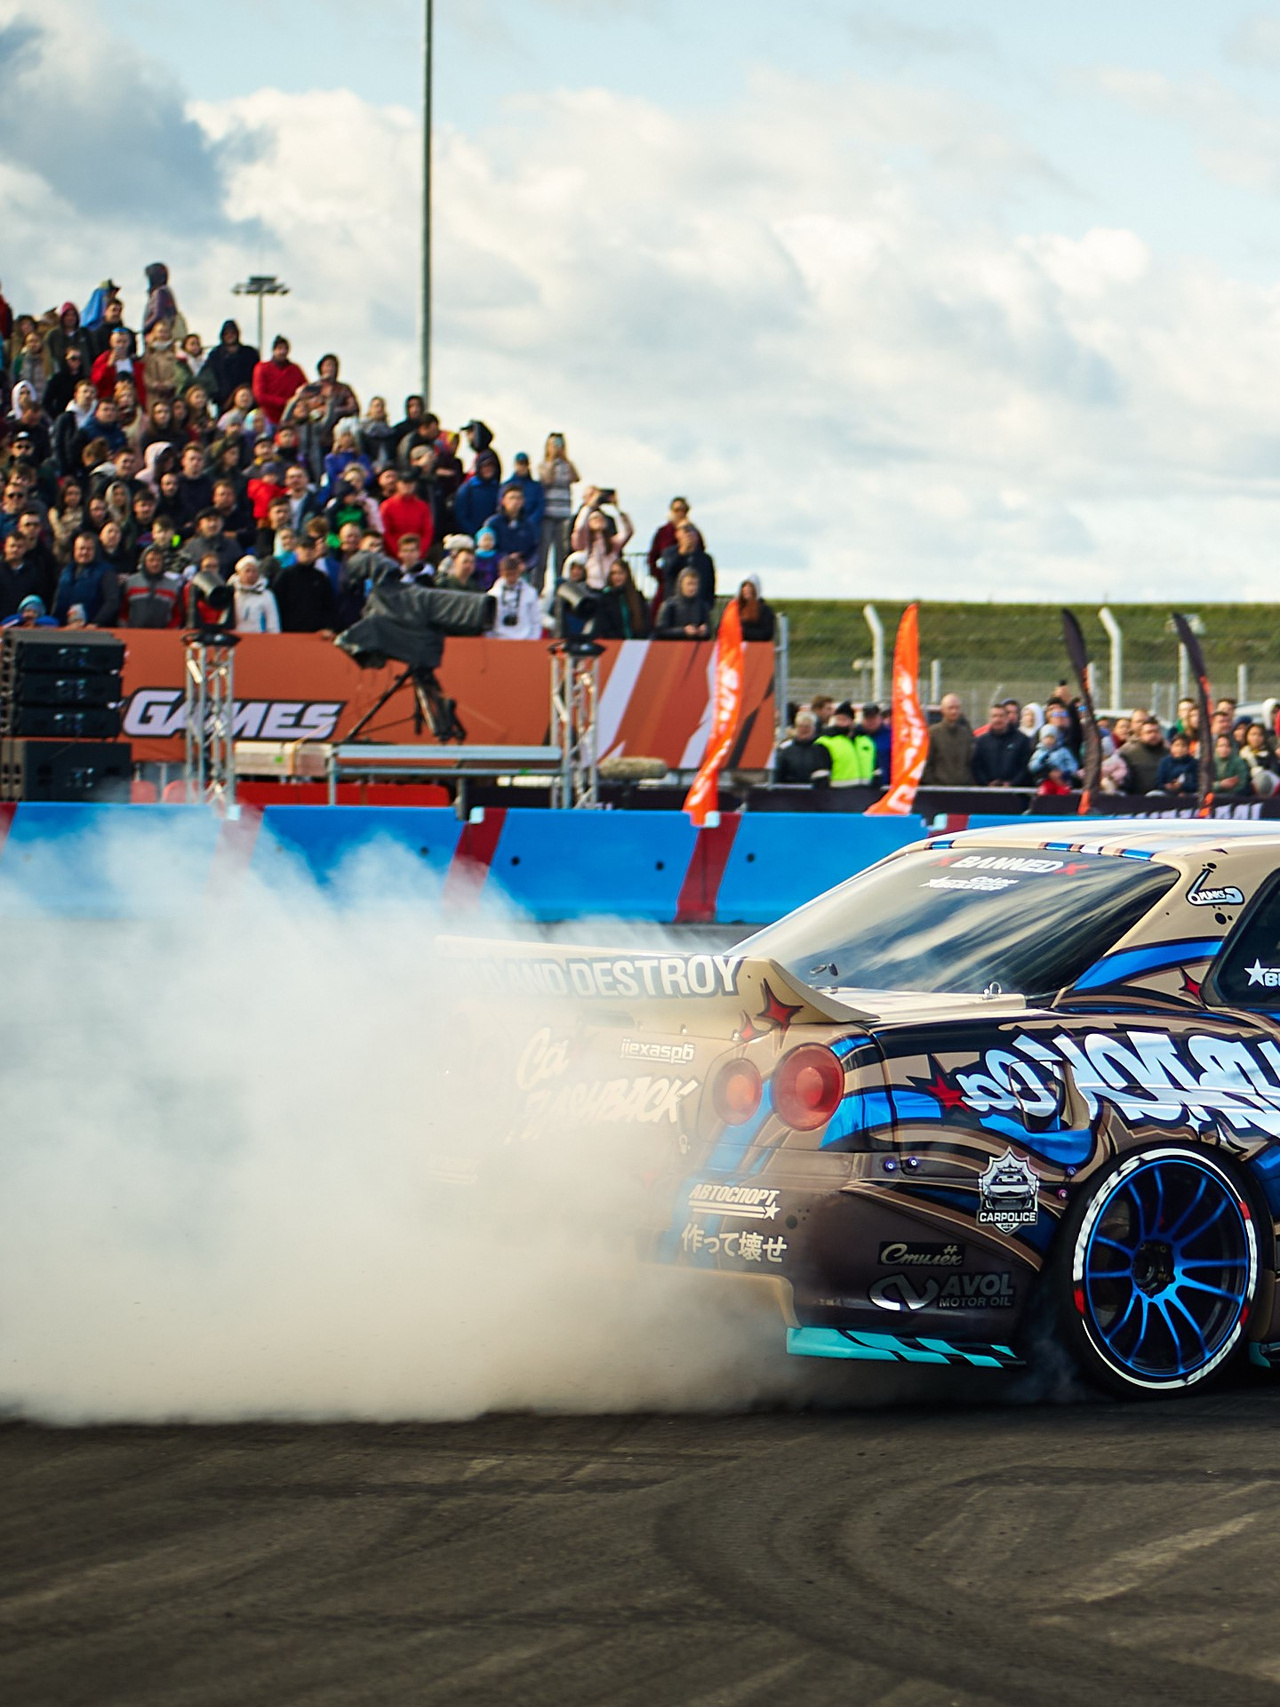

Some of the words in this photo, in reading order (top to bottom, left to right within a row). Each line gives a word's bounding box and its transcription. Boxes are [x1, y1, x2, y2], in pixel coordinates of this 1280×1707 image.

[951, 855, 1063, 873] BANNED
[570, 954, 744, 997] DESTROY
[688, 1184, 780, 1205] АВТОСПОРТ
[979, 1212, 1036, 1222] CARPOLICE
[681, 1222, 788, 1263] 作って壊せ
[941, 1274, 1014, 1296] AVOL
[939, 1297, 986, 1308] MOTOR
[990, 1297, 1012, 1306] OIL
